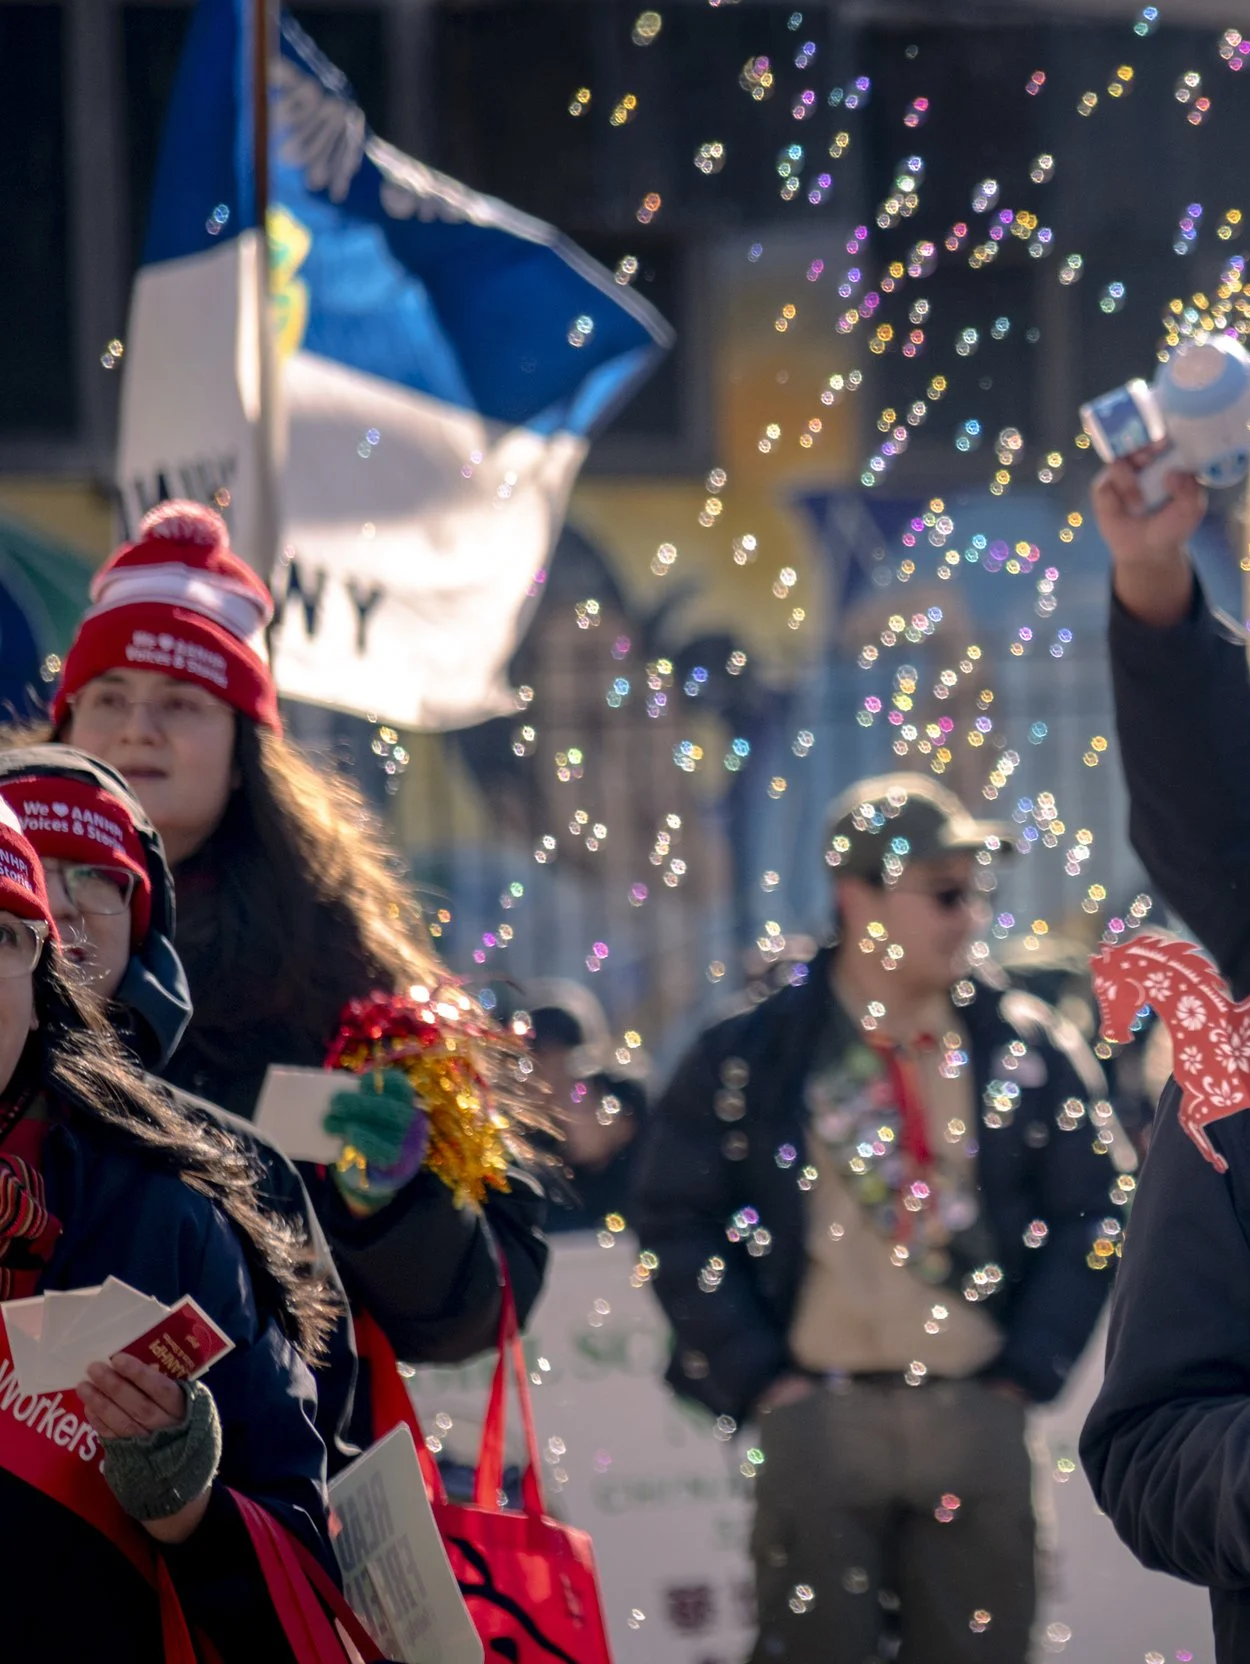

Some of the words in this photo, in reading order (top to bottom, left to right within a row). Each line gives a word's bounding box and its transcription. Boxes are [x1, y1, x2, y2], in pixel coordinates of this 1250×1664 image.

[23, 800, 49, 816] We
[20, 816, 69, 832] Voices
[72, 820, 84, 836] &
[0, 847, 28, 877] NHPI
